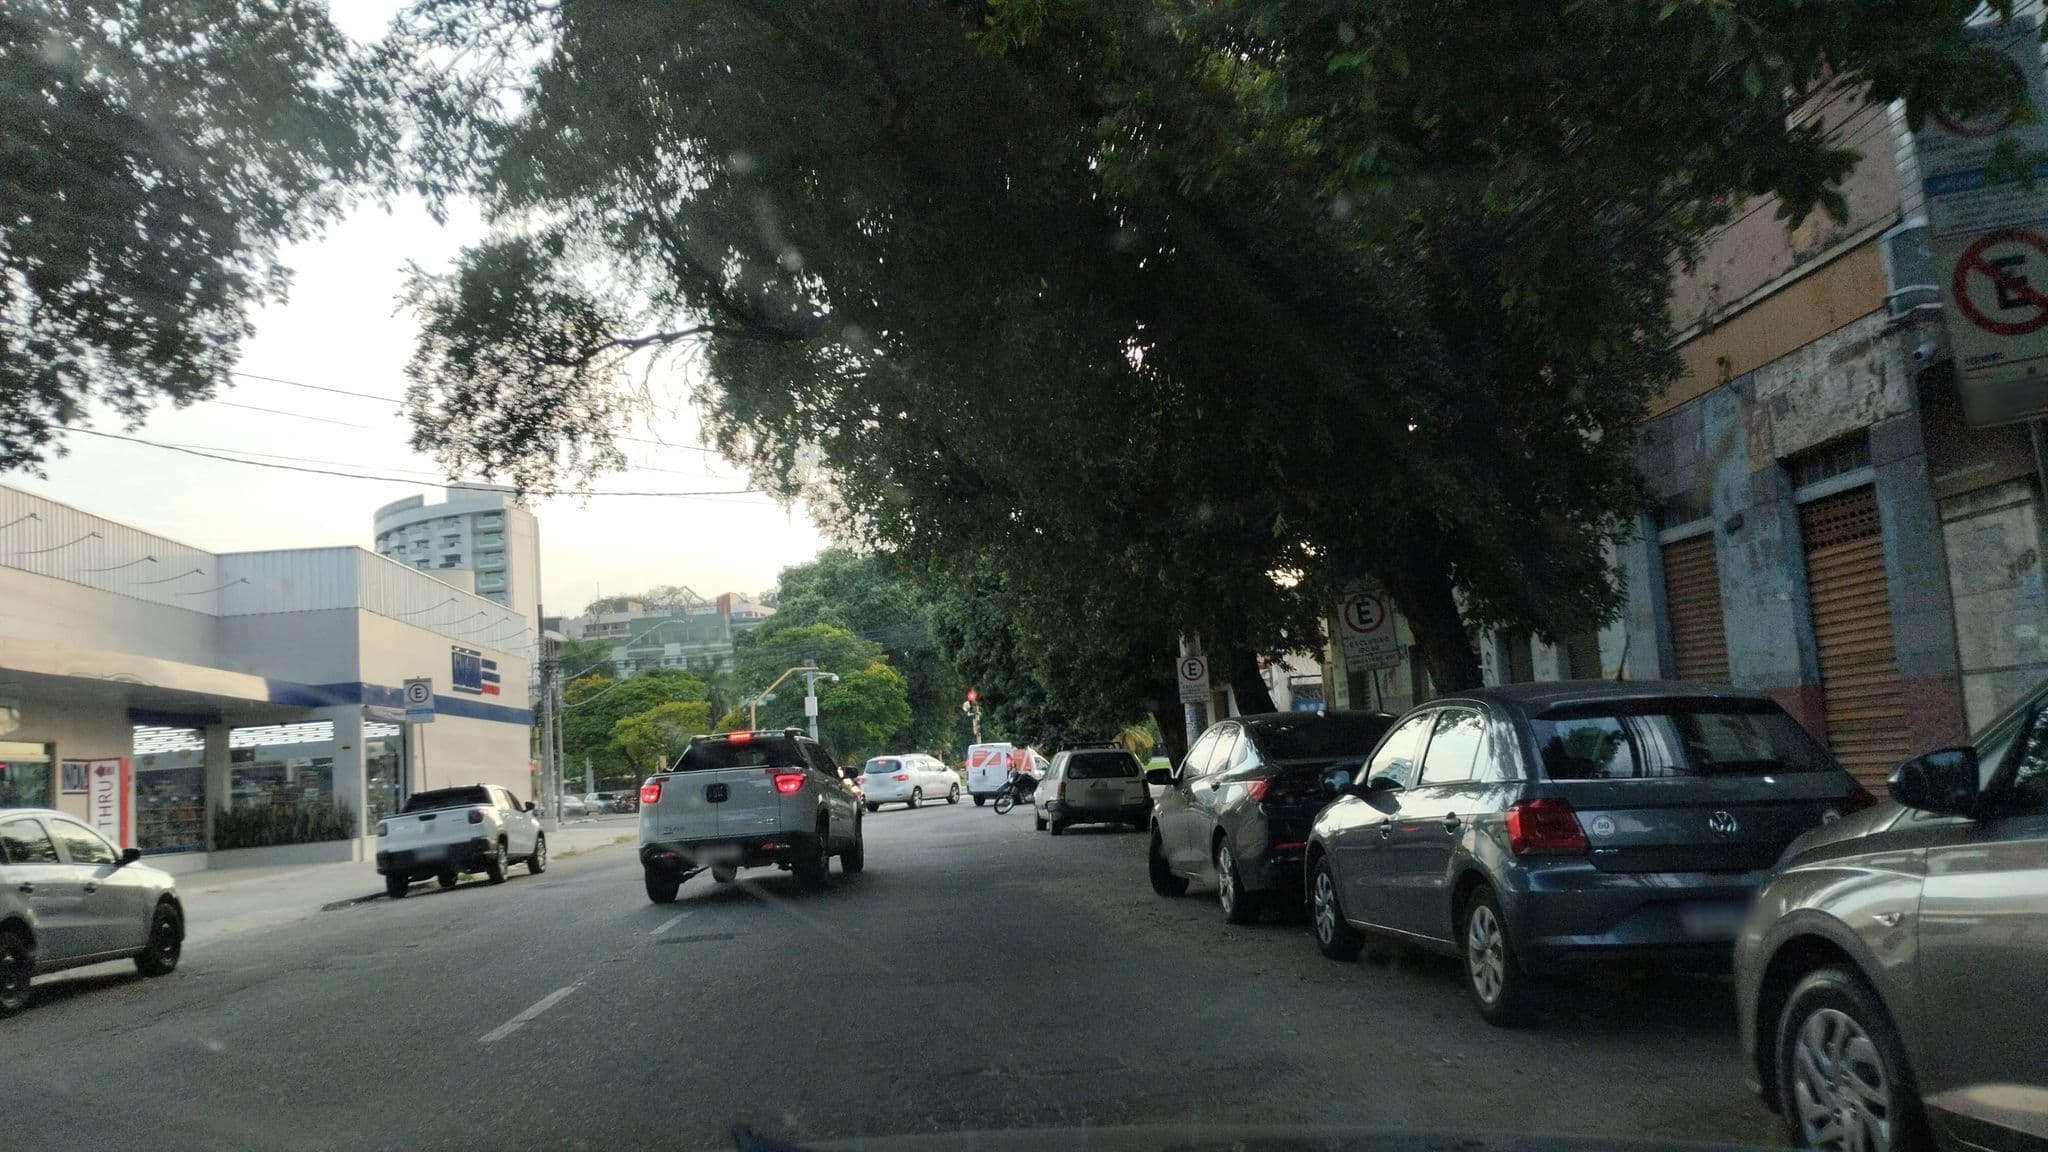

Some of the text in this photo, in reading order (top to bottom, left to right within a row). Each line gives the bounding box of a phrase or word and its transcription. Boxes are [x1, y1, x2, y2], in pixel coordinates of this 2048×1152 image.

[1989, 255, 2033, 309] E
[1357, 601, 1374, 625] E
[1188, 662, 1198, 676] E
[414, 687, 423, 699] E
[98, 780, 113, 828] THRU
